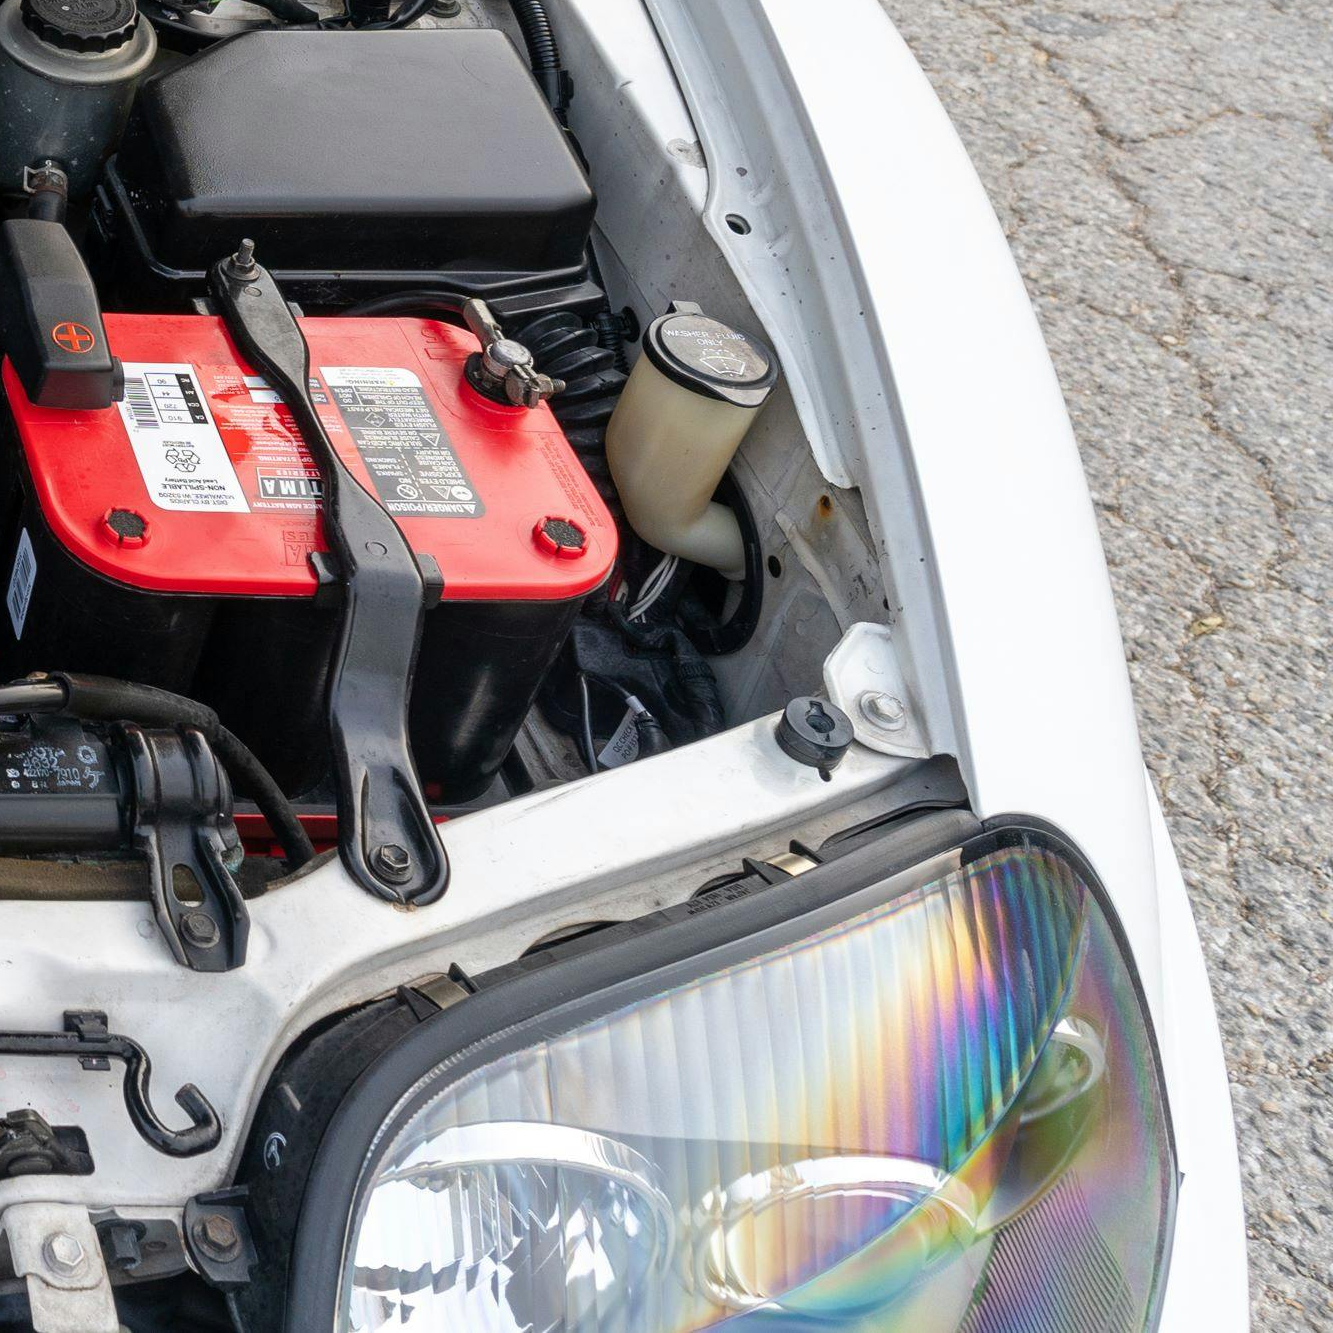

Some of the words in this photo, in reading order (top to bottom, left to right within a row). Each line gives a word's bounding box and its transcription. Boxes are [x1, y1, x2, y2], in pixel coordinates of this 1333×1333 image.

[664, 329, 710, 339] WASHER
[716, 332, 746, 342] FLUID
[696, 338, 724, 347] ONLY
[161, 483, 226, 491] NON-SPILLABLE
[263, 479, 322, 496] TIMA
[386, 502, 465, 514] DANGER/POISON
